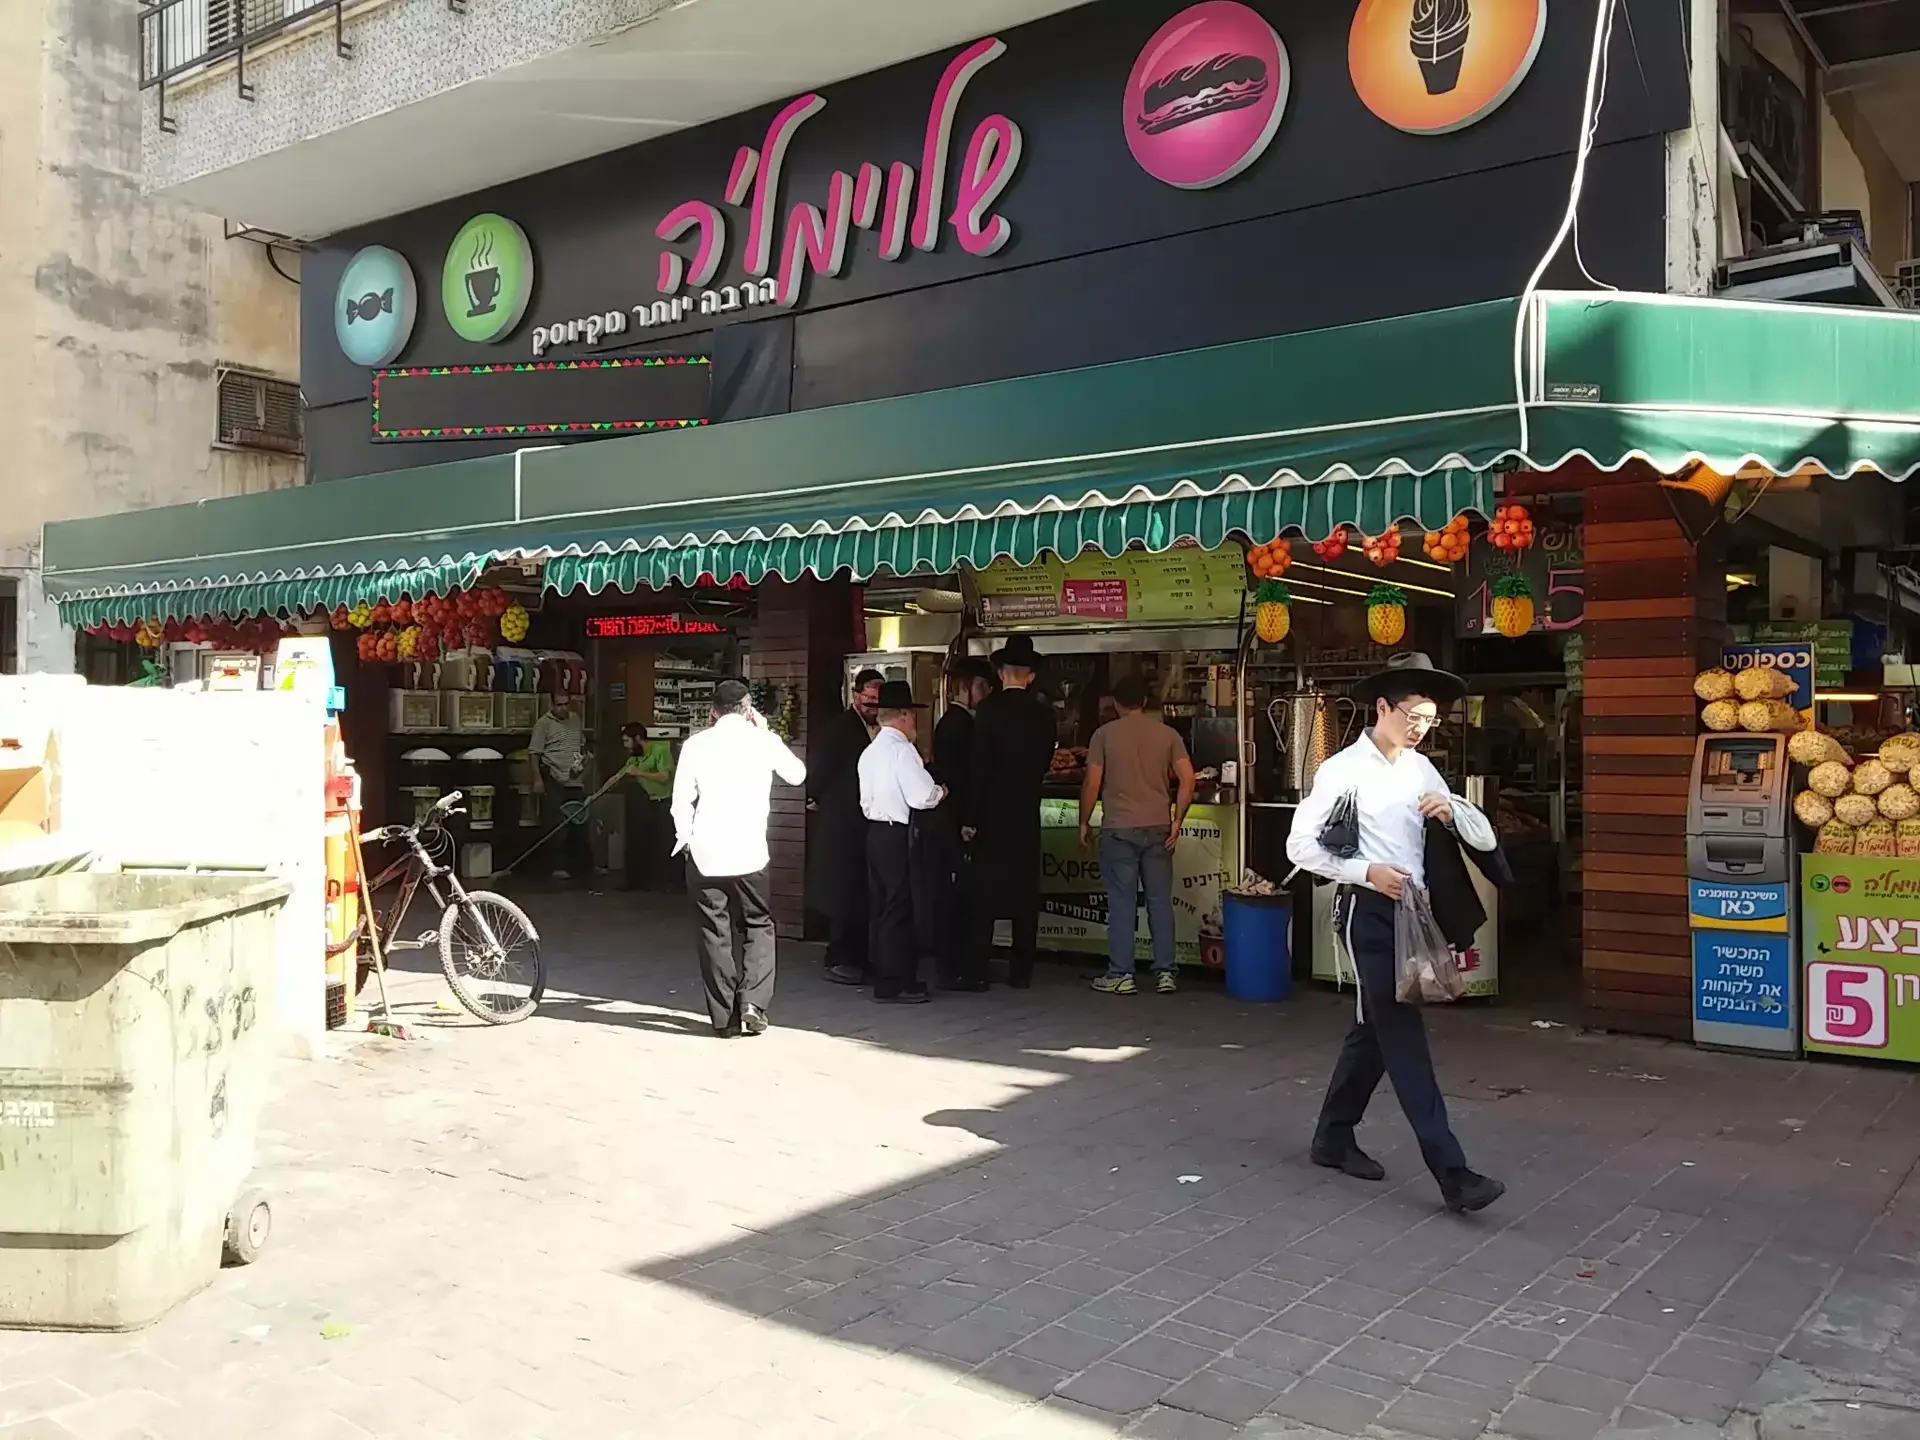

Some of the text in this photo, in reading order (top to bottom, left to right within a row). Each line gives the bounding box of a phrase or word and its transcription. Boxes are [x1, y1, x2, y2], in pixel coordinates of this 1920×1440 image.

[532, 276, 777, 356] הרבה יותר מקיוסק
[1066, 588, 1076, 602] 5
[982, 597, 991, 611] 3
[1182, 871, 1231, 889] כריכים
[1698, 888, 1778, 900] משיכת מזומנים
[1045, 900, 1100, 921] המחירים
[1720, 900, 1755, 916] כאן
[1067, 926, 1087, 937] קפה
[1712, 945, 1770, 961] המכשיר
[1718, 963, 1764, 978] משרת
[1701, 979, 1781, 996] את לקוחות
[1702, 995, 1756, 1012] הבנקים
[1826, 969, 1873, 1037] 5
